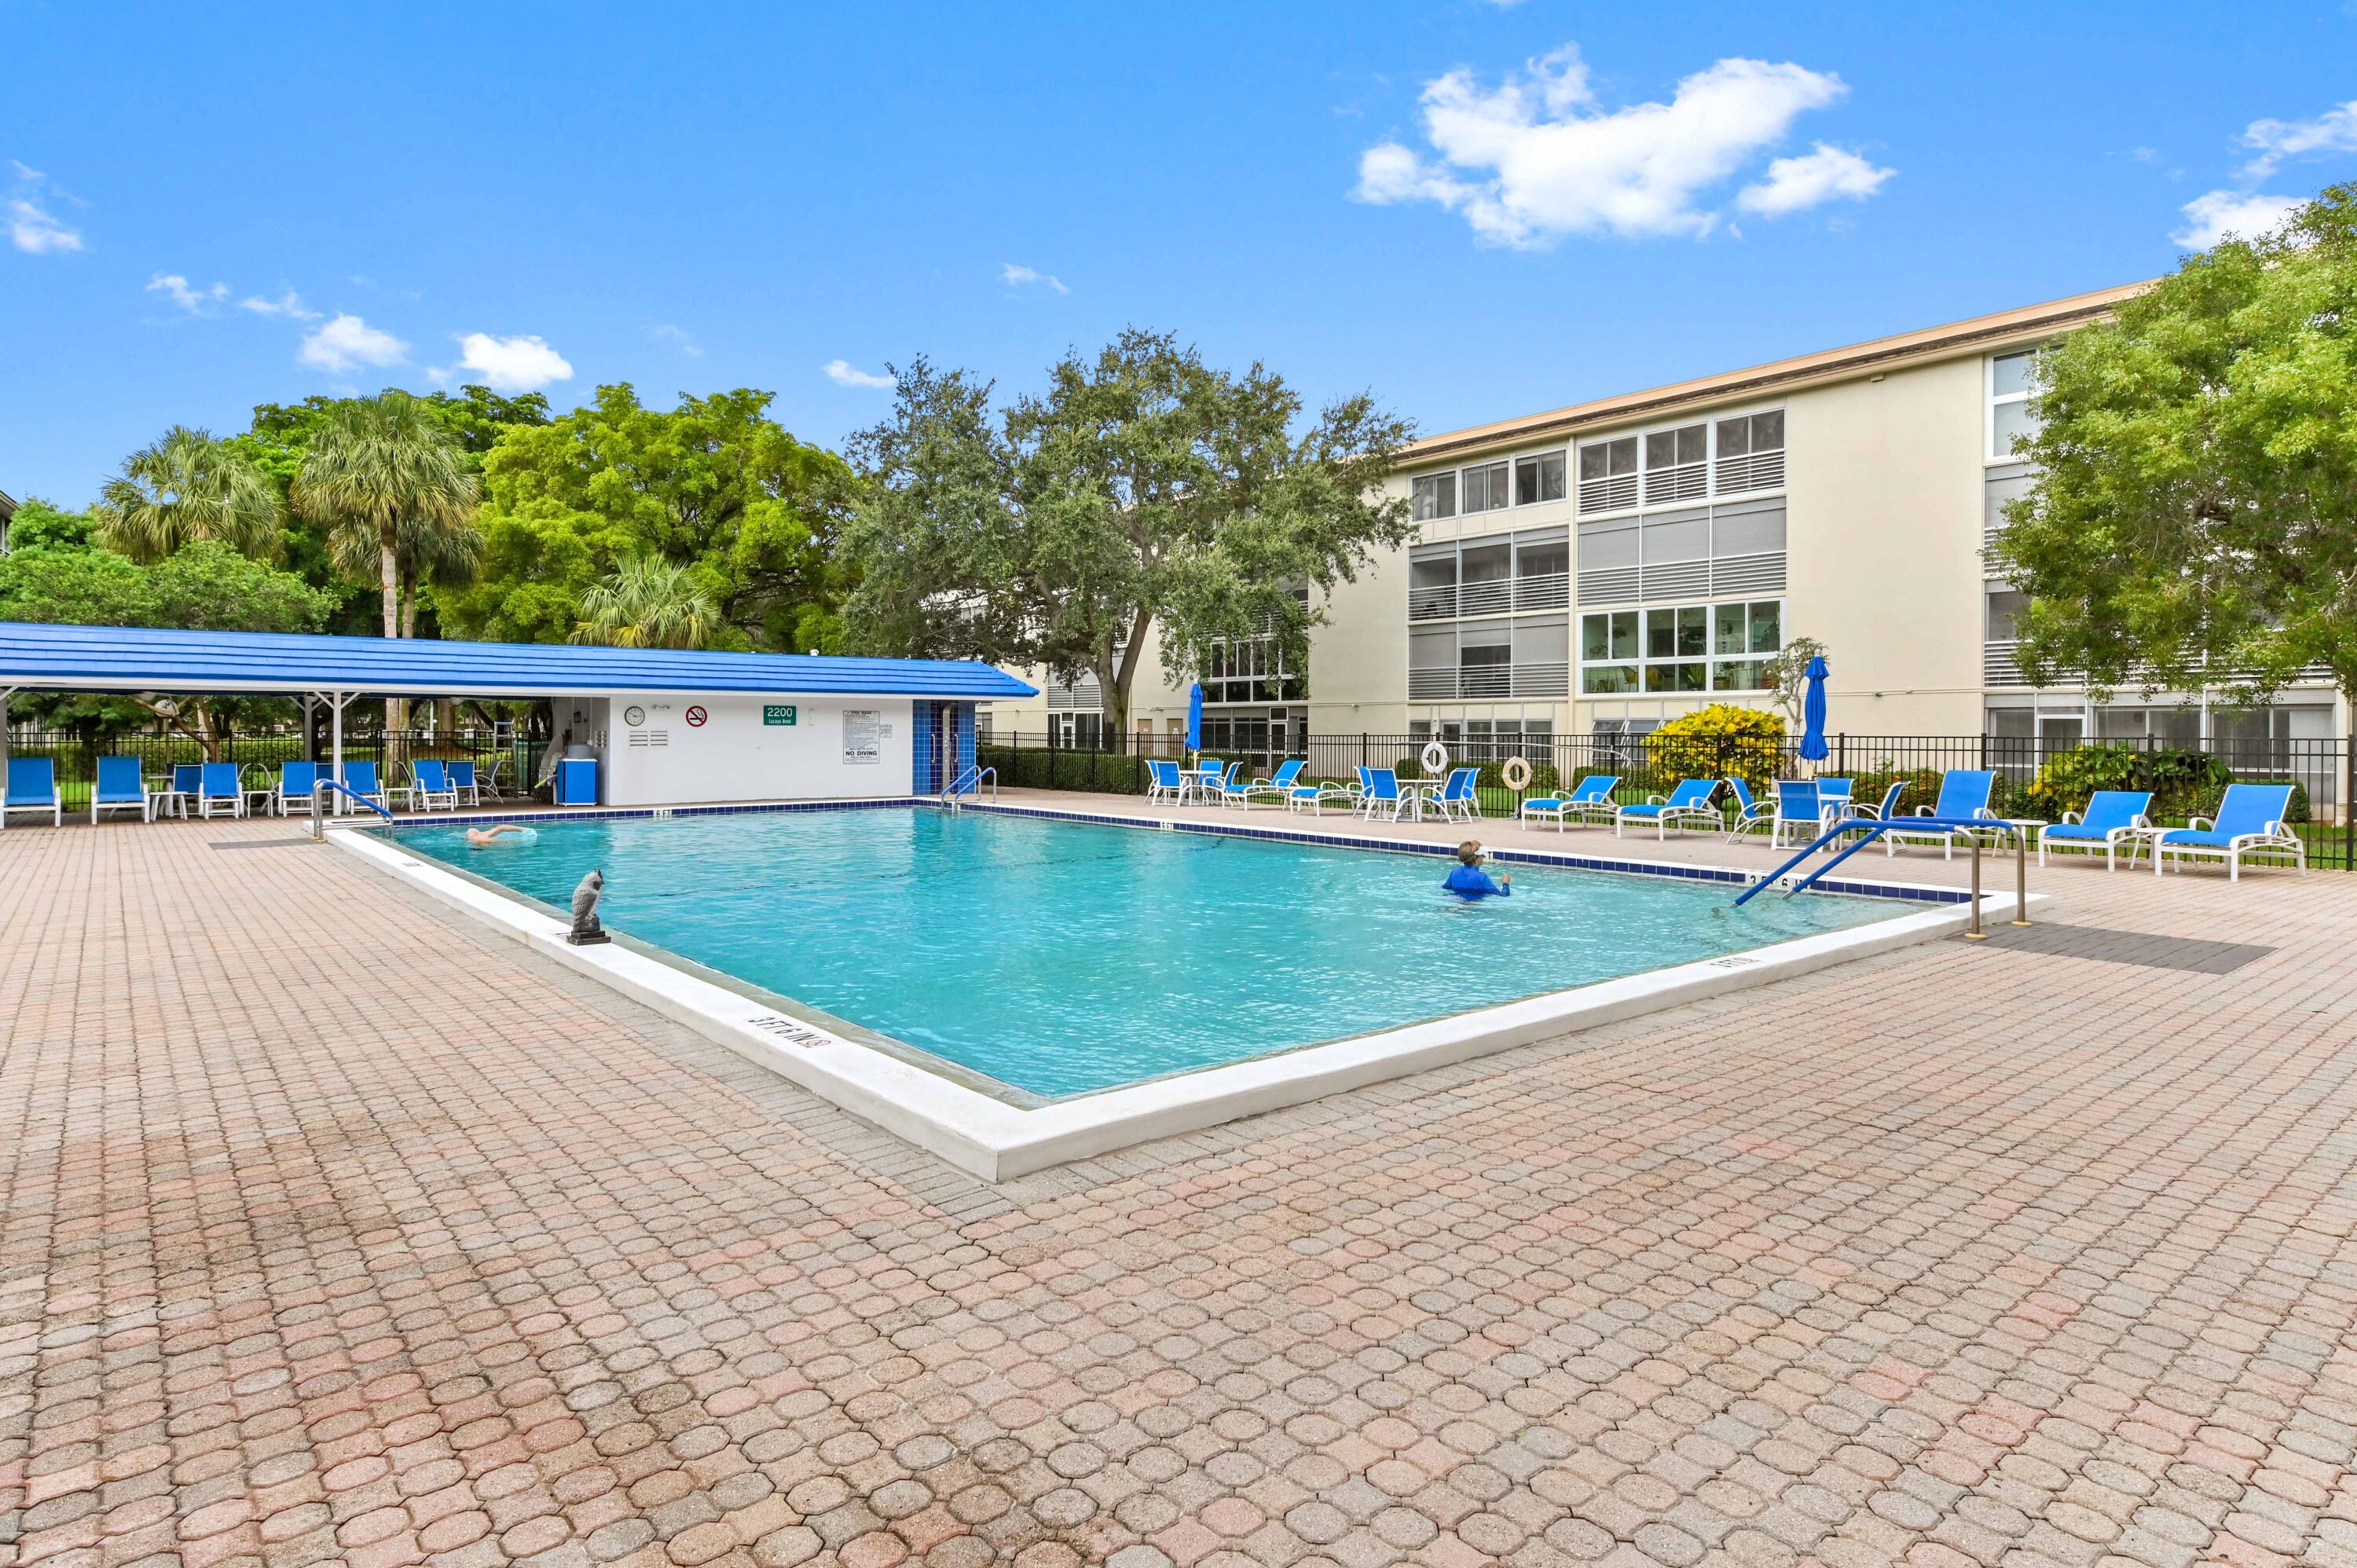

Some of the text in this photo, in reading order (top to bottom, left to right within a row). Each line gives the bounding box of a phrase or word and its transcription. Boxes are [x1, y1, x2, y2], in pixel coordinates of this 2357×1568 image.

[768, 708, 793, 717] 2200
[662, 809, 671, 818] FT
[1782, 877, 1788, 887] 6
[756, 1020, 794, 1030] FT
[784, 1032, 820, 1042] IN
